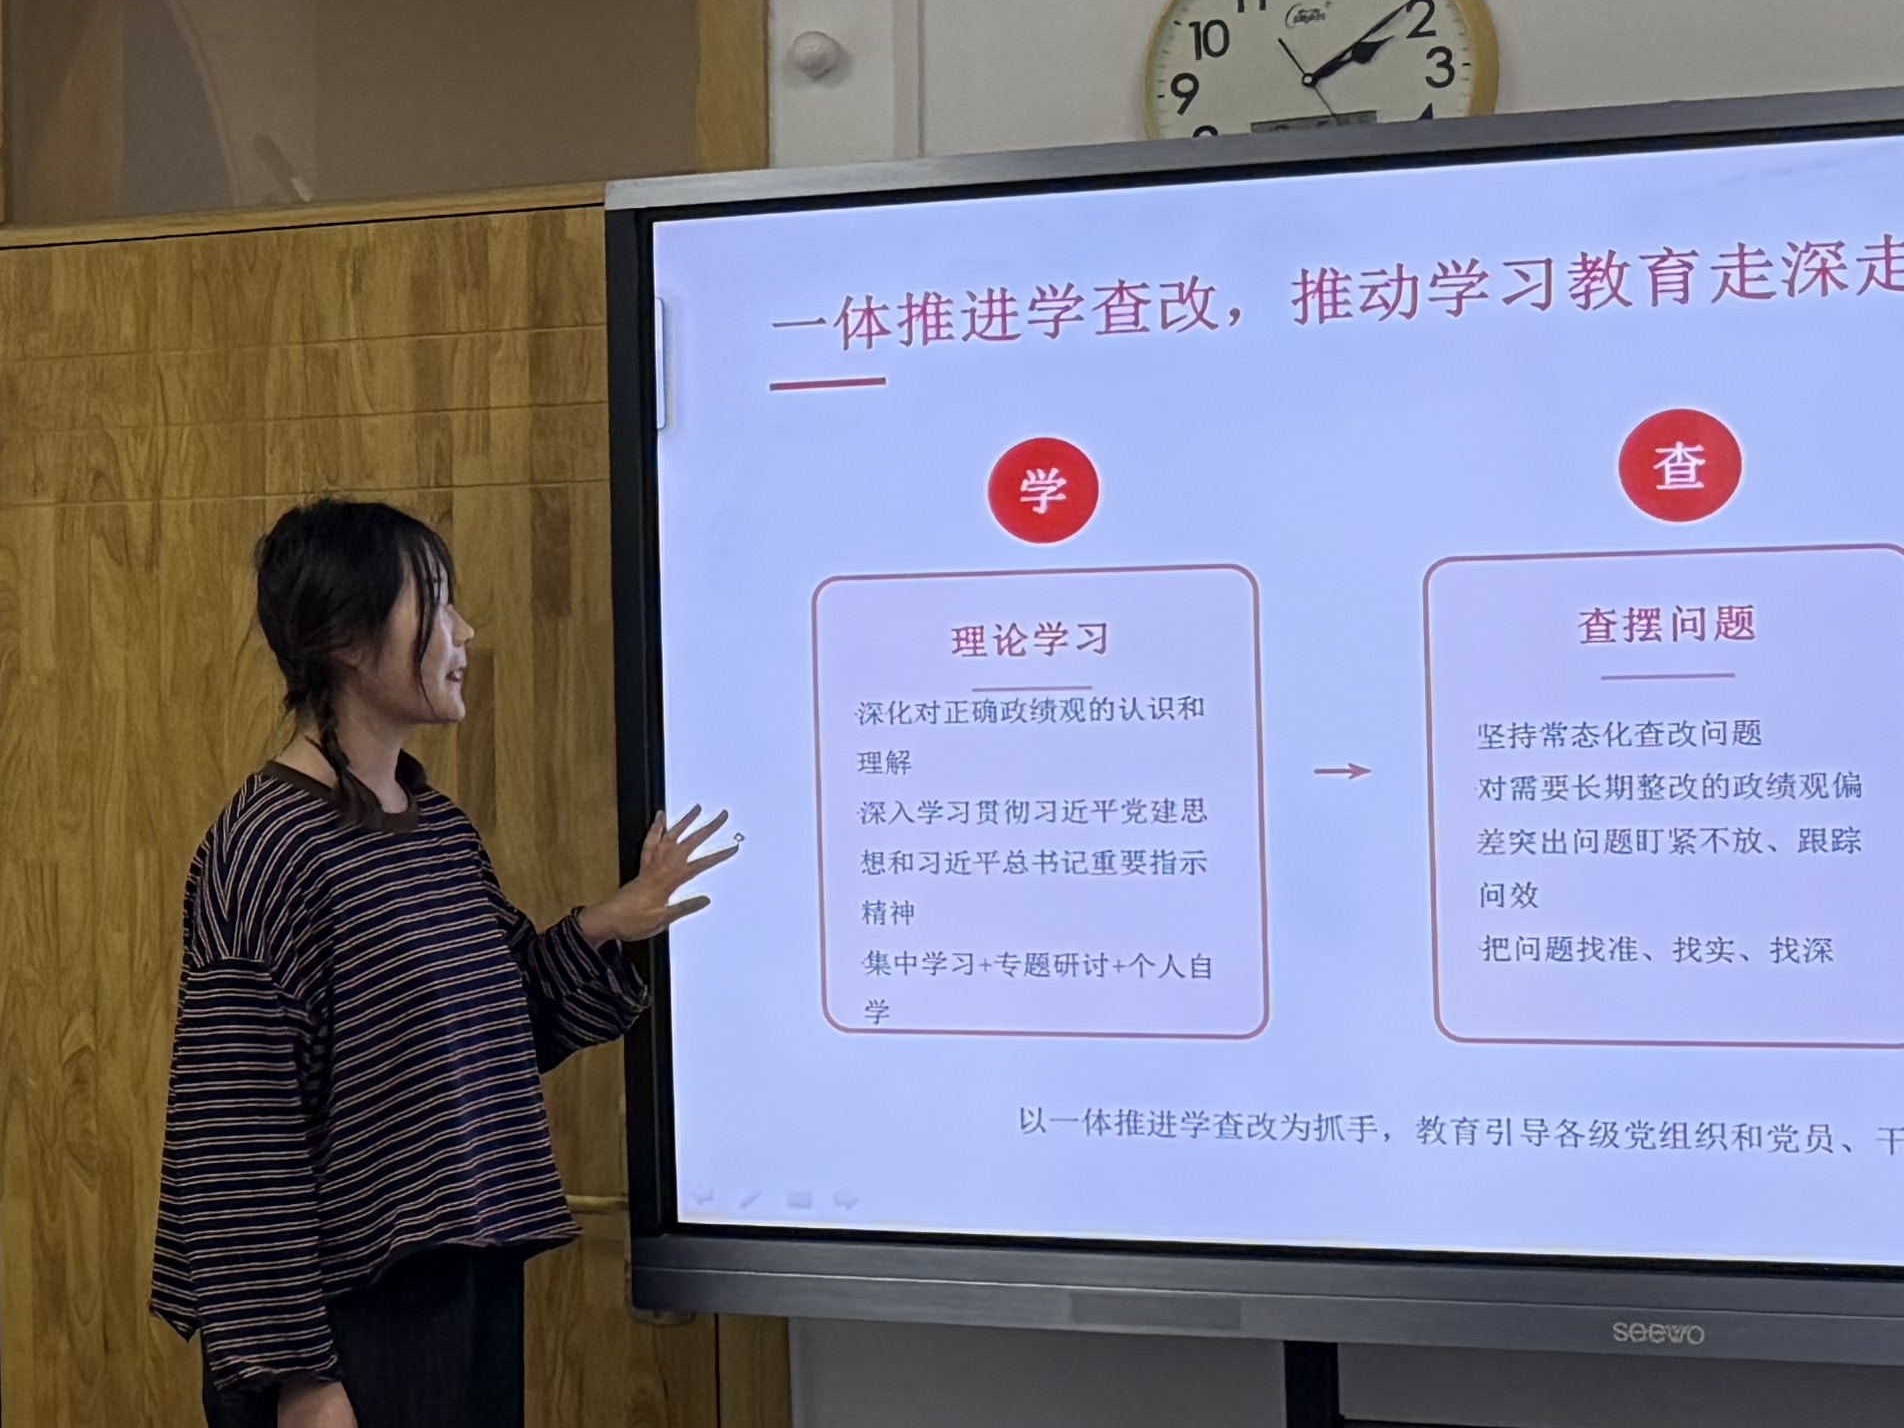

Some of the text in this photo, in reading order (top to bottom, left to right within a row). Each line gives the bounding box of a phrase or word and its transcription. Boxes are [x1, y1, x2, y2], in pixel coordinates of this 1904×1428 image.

[1189, 18, 1230, 61] 10
[1425, 45, 1455, 89] 3
[1170, 72, 1200, 116] 9
[771, 233, 1904, 351] 一体推进学查改，推动学习教育走深走
[1652, 441, 1707, 491] 查
[1019, 464, 1070, 515] 学
[951, 621, 1108, 658] 理论学习
[1578, 604, 1757, 645] 查摆问题
[1477, 718, 1763, 751] 坚持常态化查改问题
[856, 749, 912, 776] 理解
[1476, 825, 1863, 857] 差突出问题盯紧不放、跟踪
[859, 848, 1208, 877] 想和习近平总书记重要指示
[860, 899, 915, 927] 精神
[1479, 881, 1540, 909] 问效
[864, 998, 891, 1026] 学
